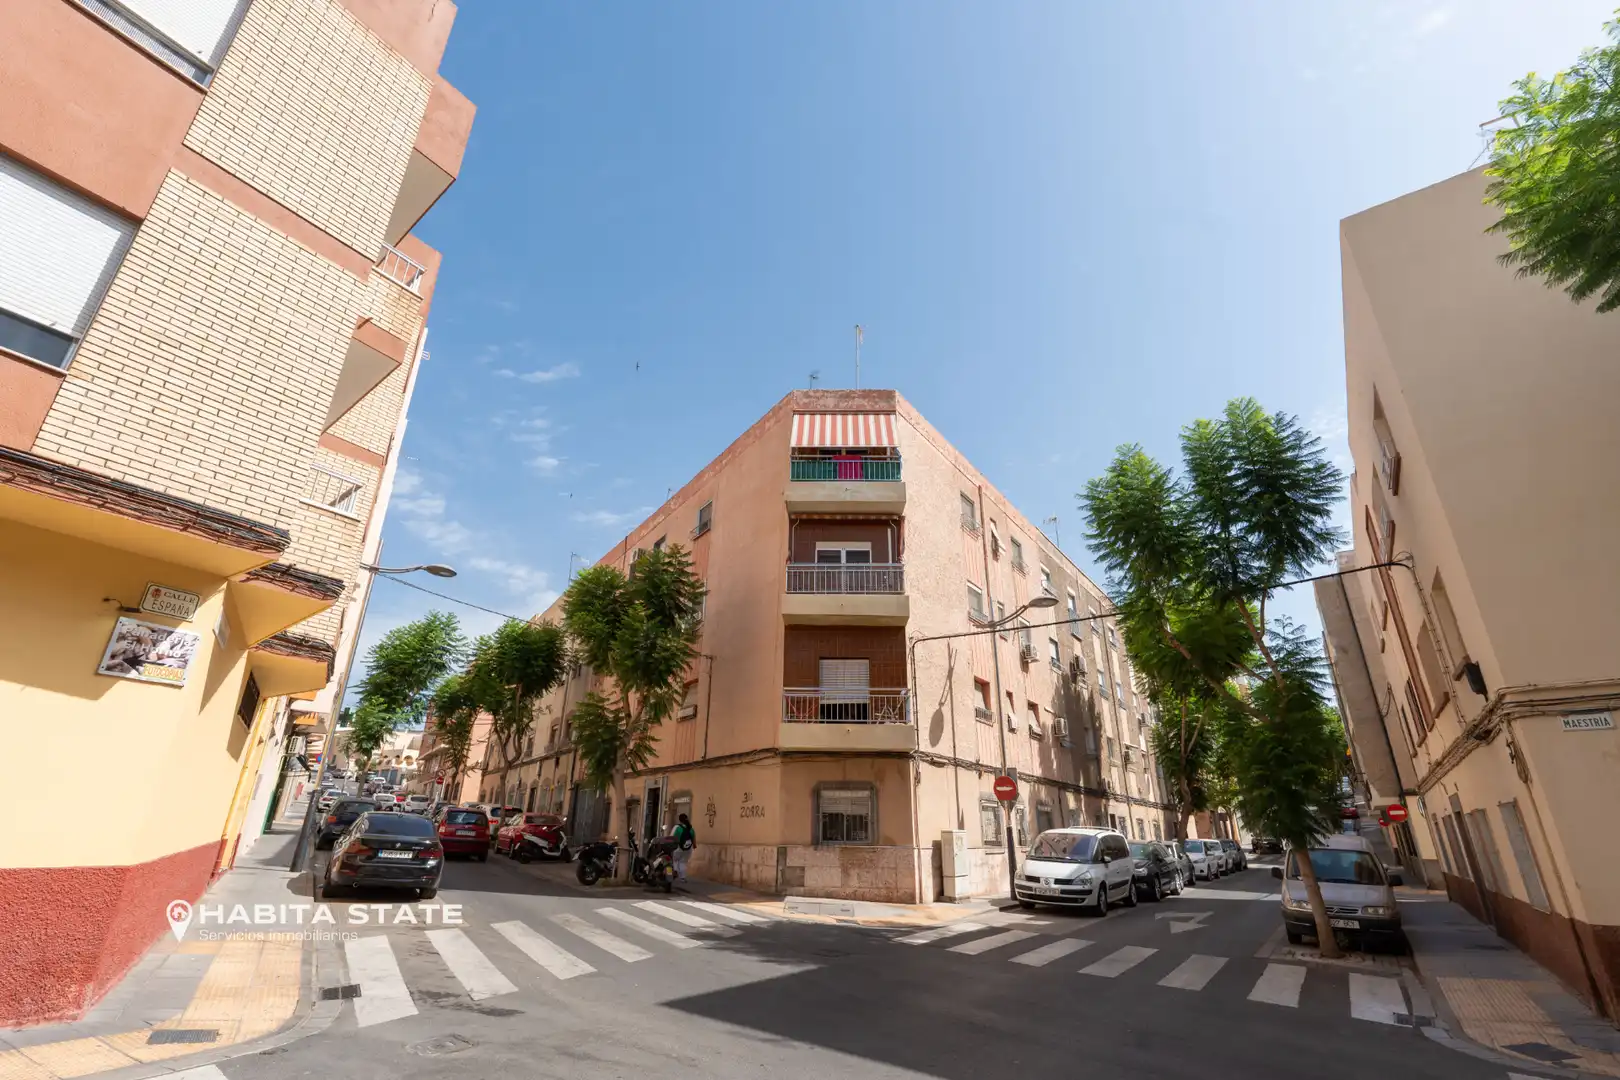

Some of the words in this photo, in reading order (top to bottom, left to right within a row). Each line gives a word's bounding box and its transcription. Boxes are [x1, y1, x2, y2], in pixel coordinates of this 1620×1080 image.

[163, 590, 198, 604] CALLE
[151, 599, 191, 617] ESPAÑA
[125, 639, 137, 651] El
[141, 643, 182, 658] Horno
[740, 805, 766, 818] ZORRA
